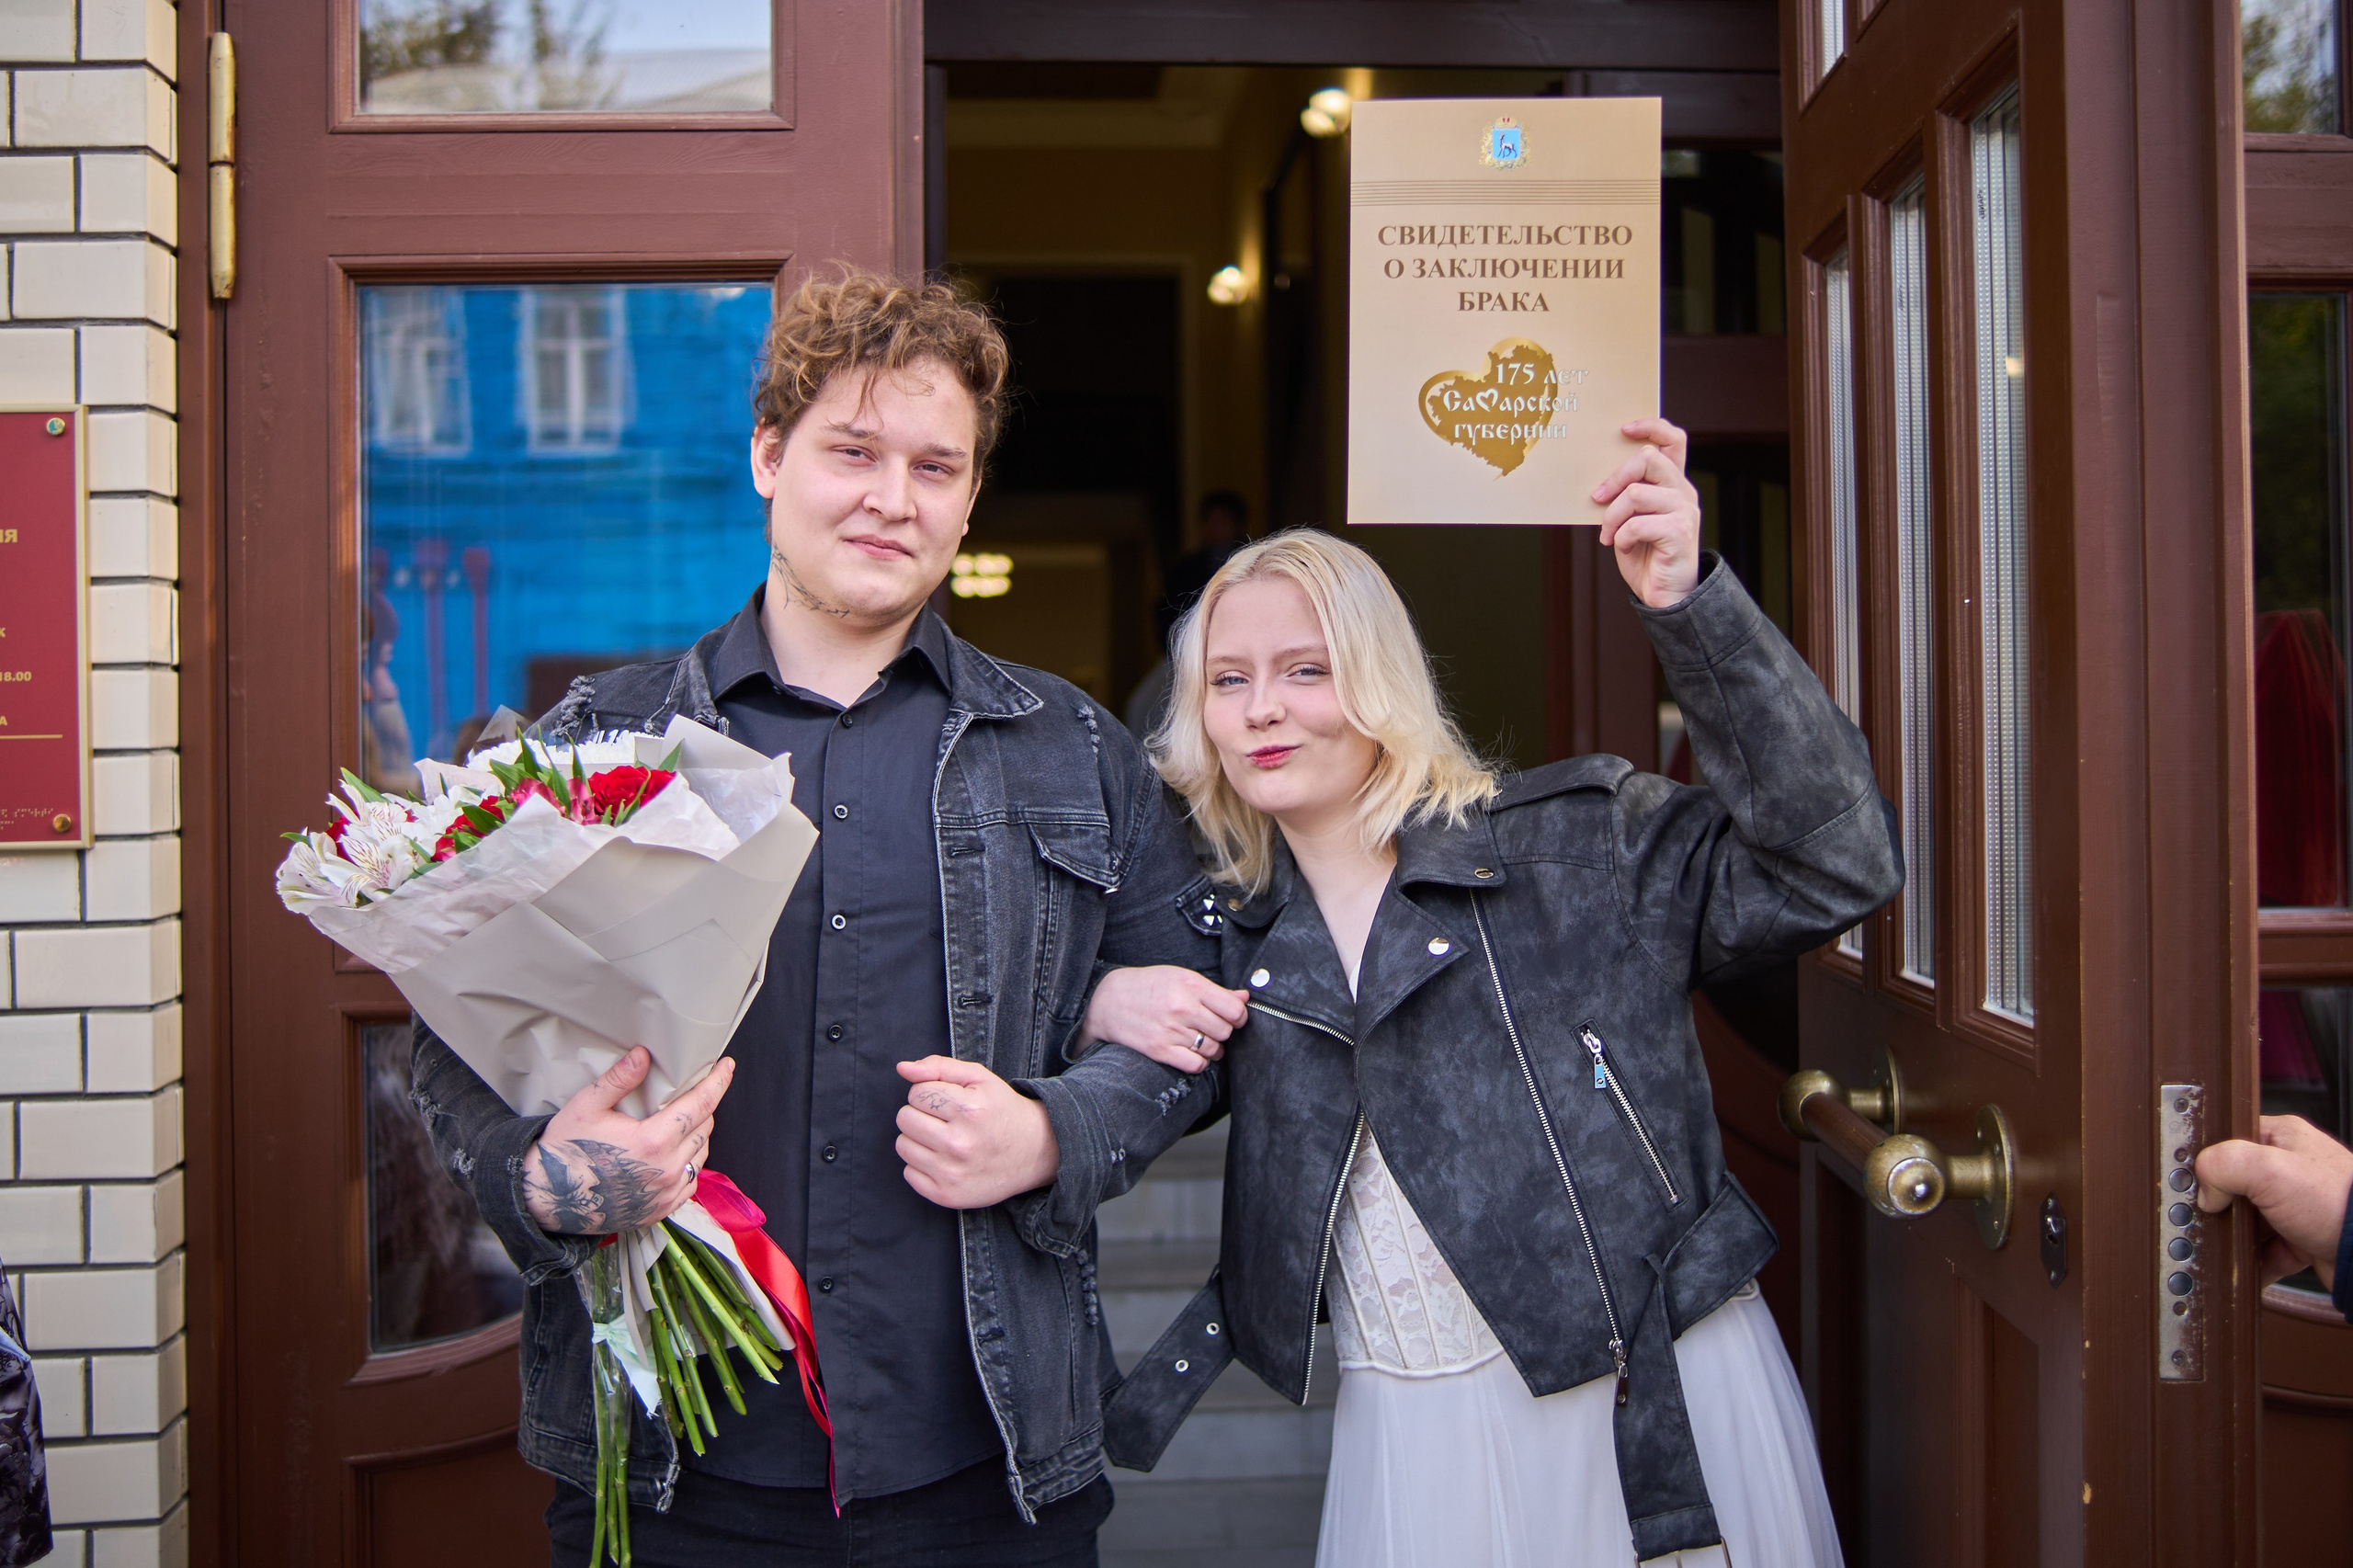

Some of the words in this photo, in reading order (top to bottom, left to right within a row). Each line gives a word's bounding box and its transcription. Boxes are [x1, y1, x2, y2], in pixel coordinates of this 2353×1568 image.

[1378, 225, 1632, 248] СВИДЕТЕЛЬСТВО
[1383, 258, 1404, 279] О
[1413, 258, 1624, 279] ЗАКЛЮЧЕНИИ
[1458, 291, 1550, 312] БРАКА
[1495, 363, 1535, 385] 175
